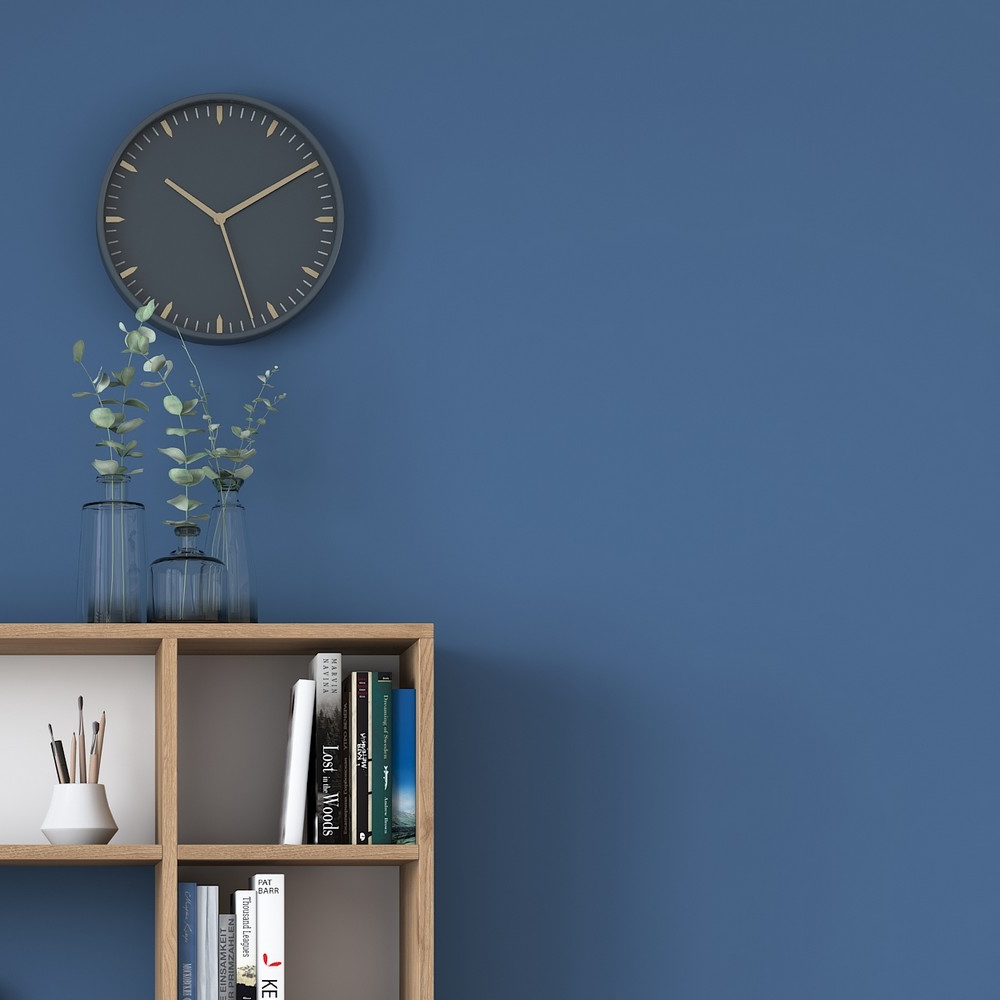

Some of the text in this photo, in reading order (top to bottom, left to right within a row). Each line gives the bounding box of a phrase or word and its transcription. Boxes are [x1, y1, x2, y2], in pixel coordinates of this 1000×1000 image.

[322, 745, 339, 773] Lost
[322, 783, 331, 793] the
[322, 792, 339, 837] Woods
[240, 896, 252, 958] Thousand Leagues
